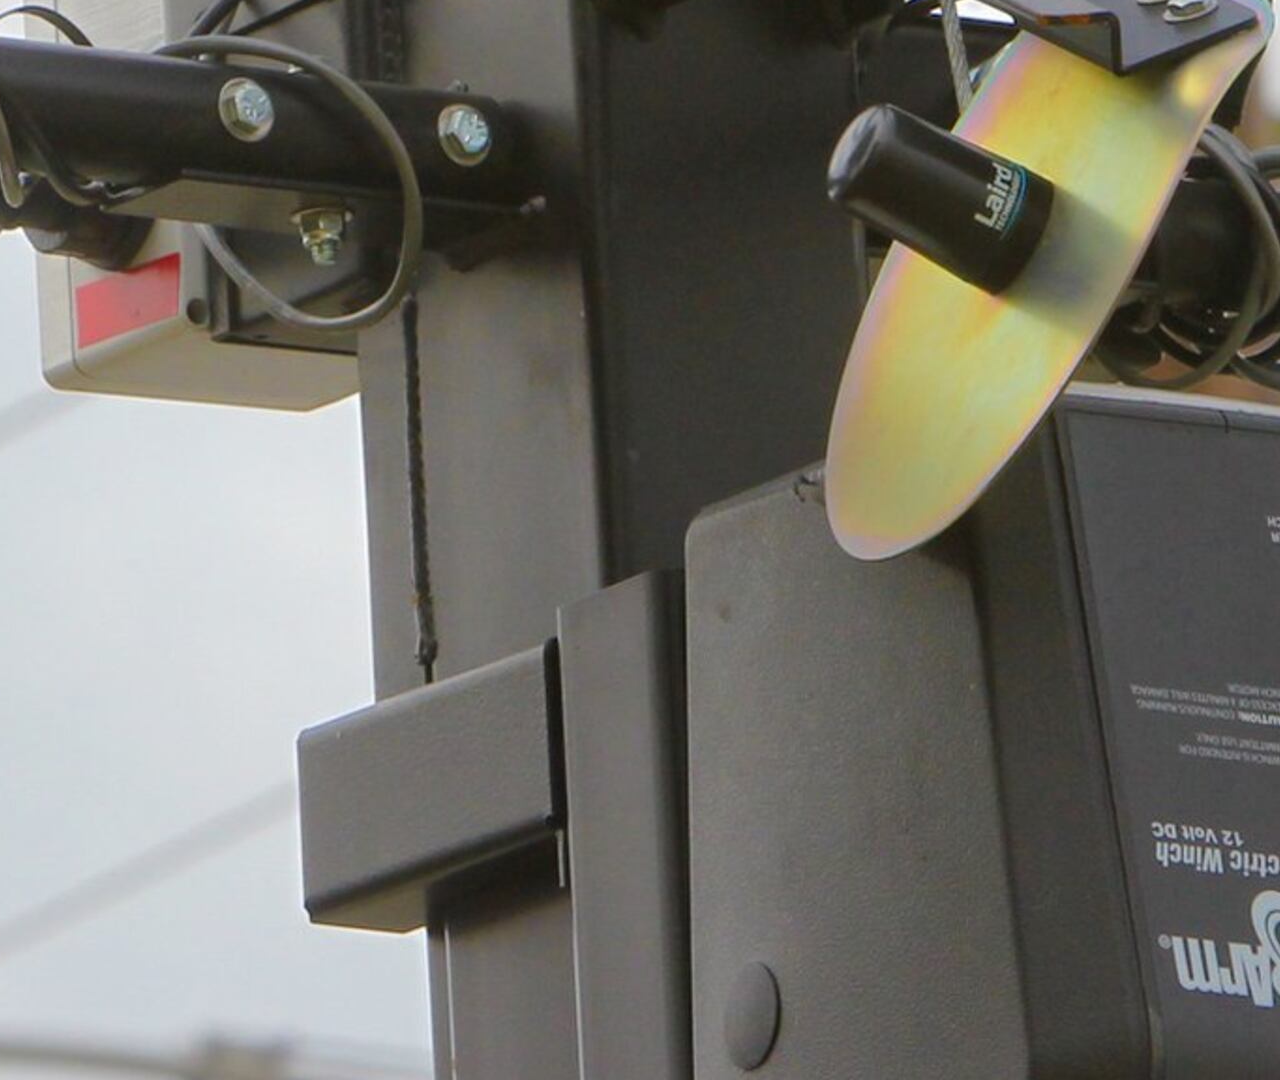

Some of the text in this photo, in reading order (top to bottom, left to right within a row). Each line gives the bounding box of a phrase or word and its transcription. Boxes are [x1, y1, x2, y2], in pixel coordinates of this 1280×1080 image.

[974, 162, 1012, 226] Laird
[1151, 821, 1244, 847] 12 Volt DC
[1154, 841, 1223, 874] Winch
